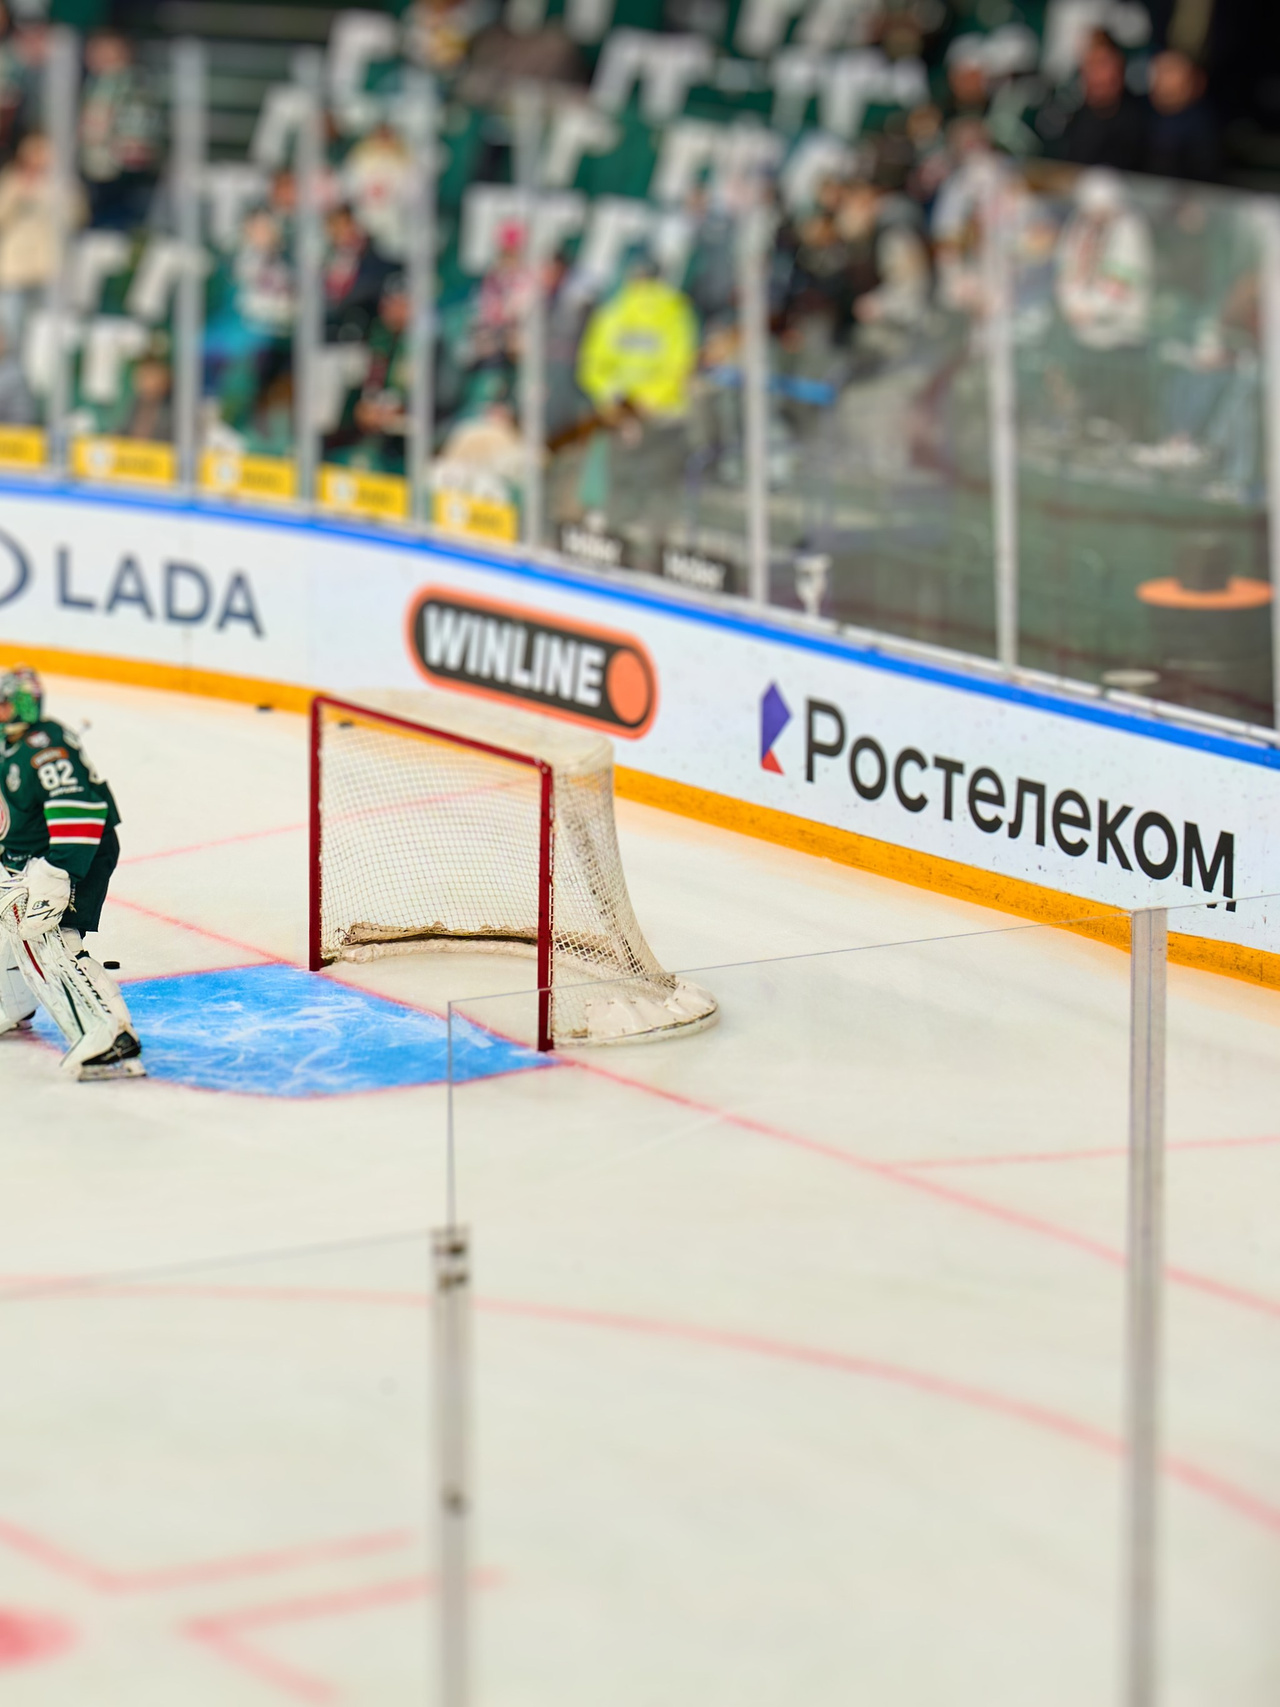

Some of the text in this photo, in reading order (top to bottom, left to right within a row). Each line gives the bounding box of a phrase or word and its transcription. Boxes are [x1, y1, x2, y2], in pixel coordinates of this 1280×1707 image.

[54, 543, 266, 639] LADA
[423, 603, 606, 708] WINLINE
[37, 759, 79, 792] 82
[804, 696, 1236, 912] Ростелеком
